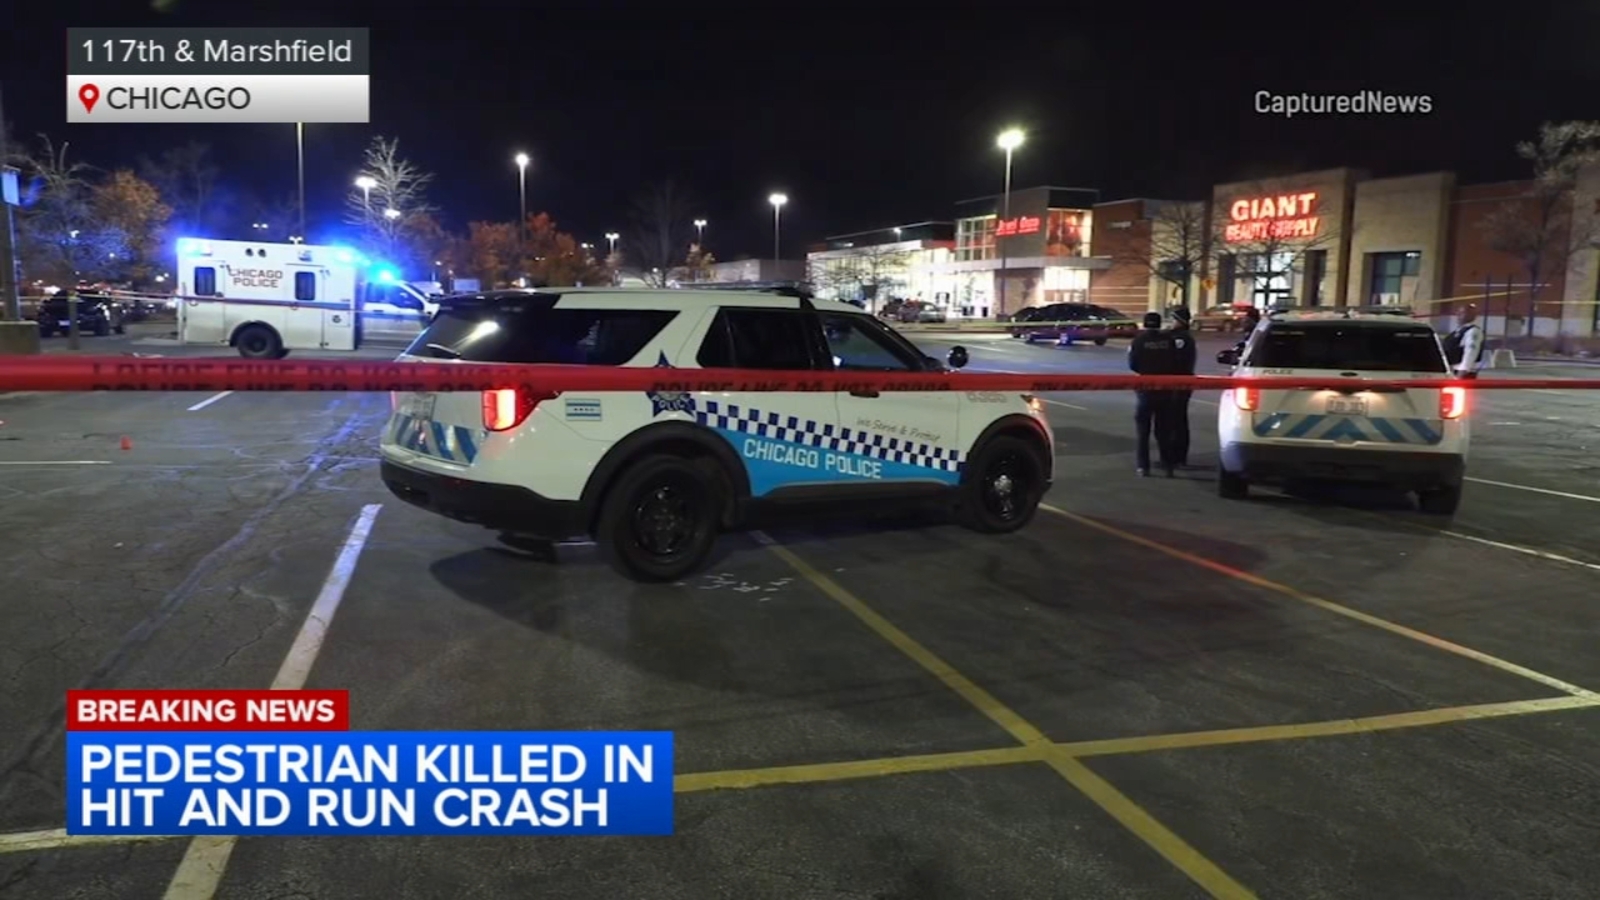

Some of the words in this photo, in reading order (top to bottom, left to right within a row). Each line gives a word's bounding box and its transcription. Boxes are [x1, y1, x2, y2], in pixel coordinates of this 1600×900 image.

[1230, 192, 1317, 221] GIANT
[1225, 220, 1268, 241] BEAUTY
[228, 269, 284, 279] CHICAGO
[233, 277, 279, 288] POLICE
[743, 438, 819, 469] CHICAGO
[824, 453, 883, 480] POLICE
